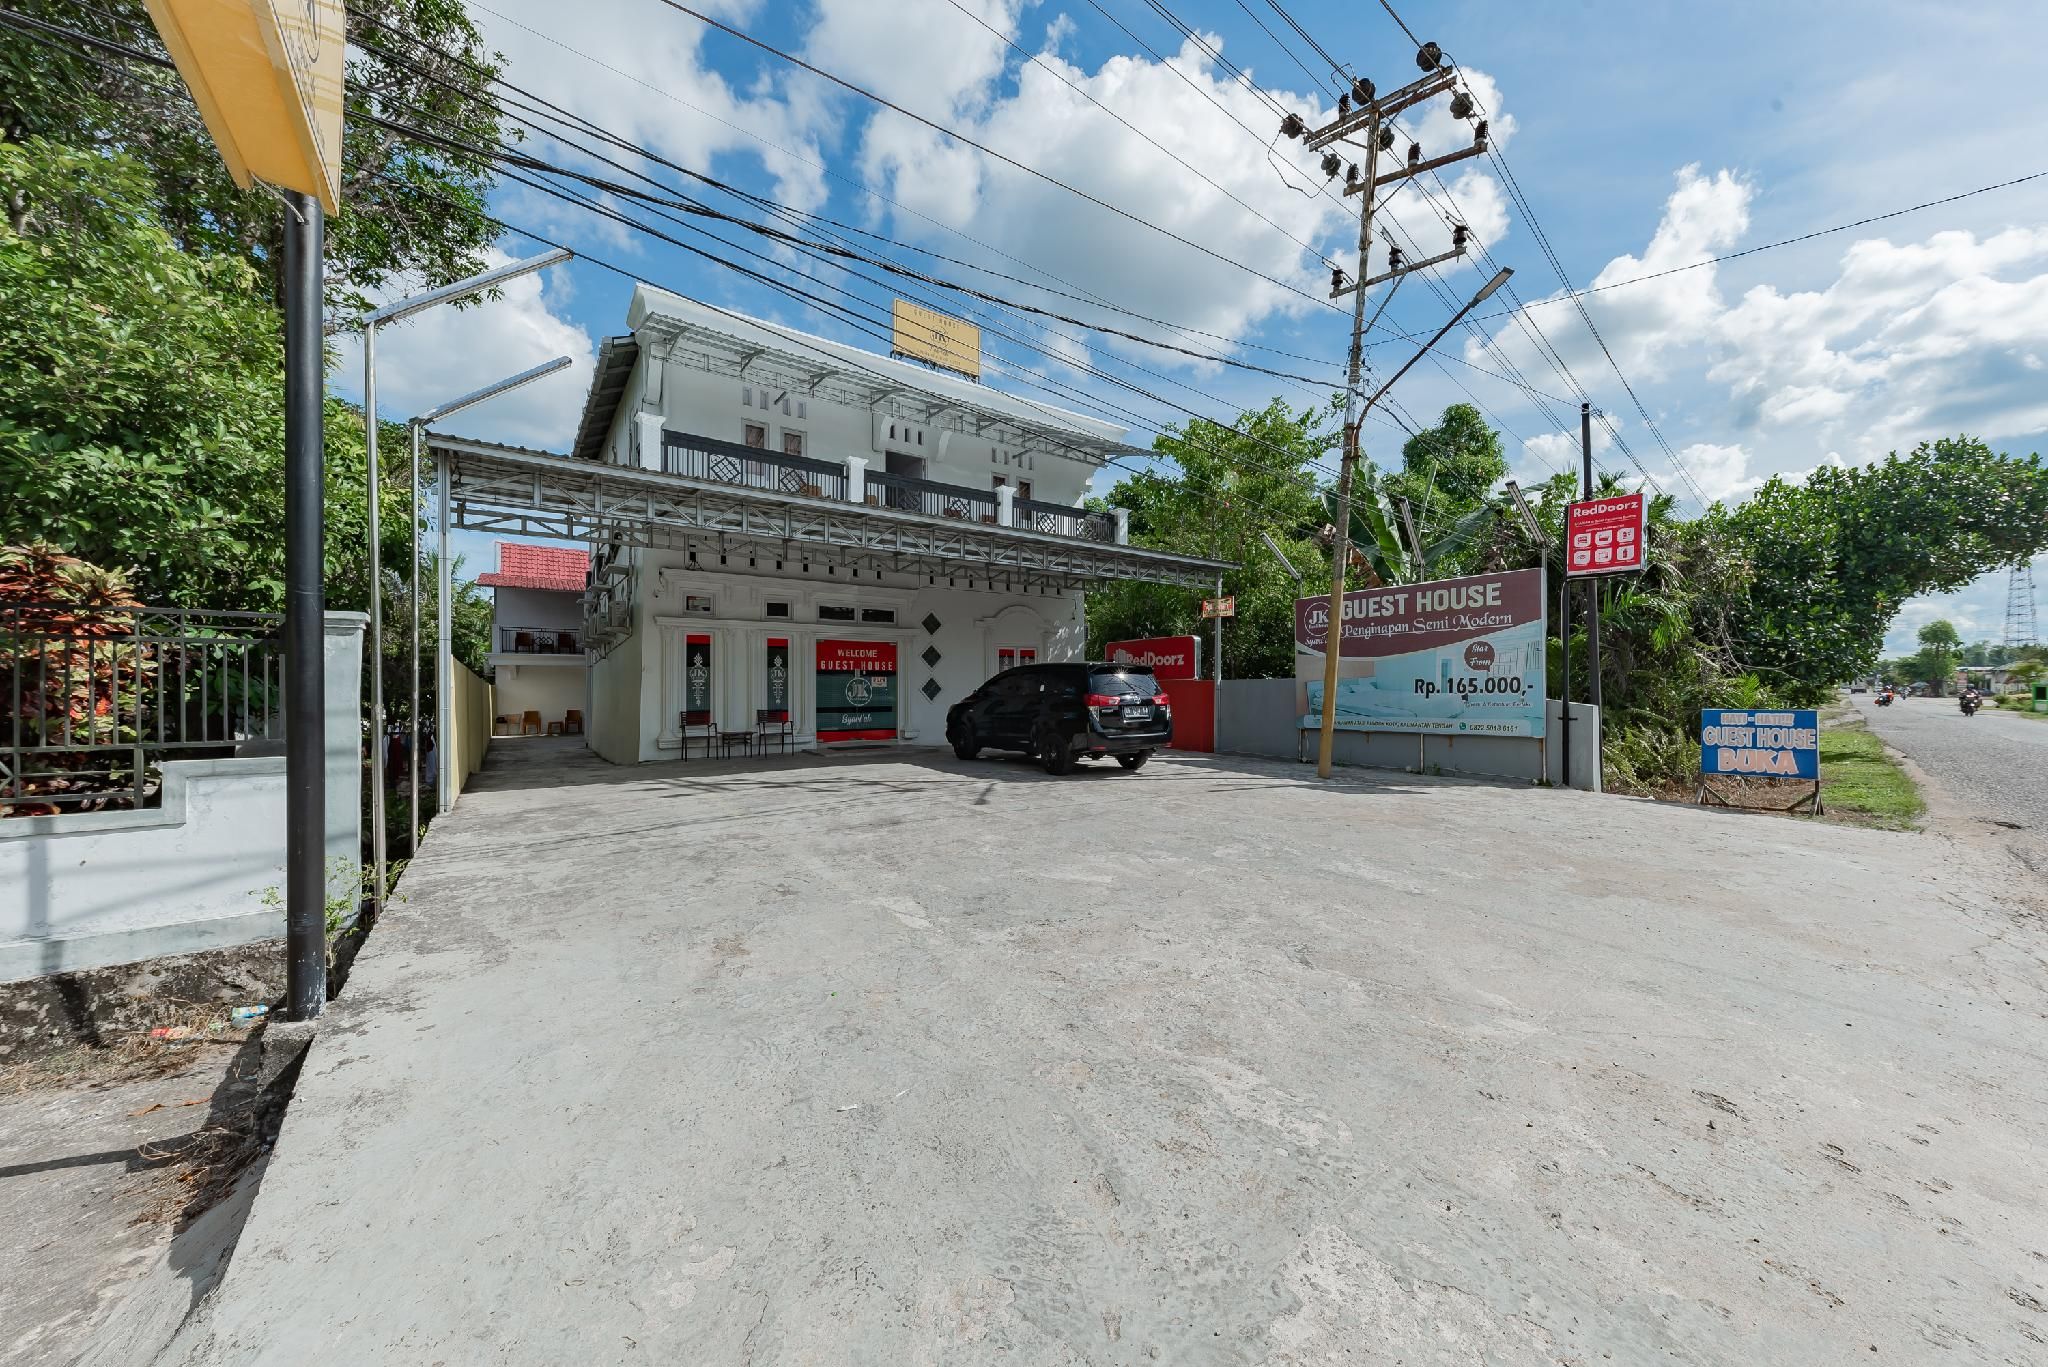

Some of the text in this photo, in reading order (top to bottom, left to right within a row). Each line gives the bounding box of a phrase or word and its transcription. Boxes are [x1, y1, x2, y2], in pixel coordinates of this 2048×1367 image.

[1573, 501, 1639, 518] RedDoorz
[1341, 583, 1502, 620] GUEST HOUSE
[1341, 611, 1513, 639] Penginapan Semi Modern
[837, 649, 878, 658] WELCOME
[820, 660, 893, 671] GUEST HOUSE
[1414, 676, 1534, 699] Rp. 165.000,-
[1702, 726, 1817, 750] GUEST HOUSE
[1717, 748, 1799, 775] BUKA
